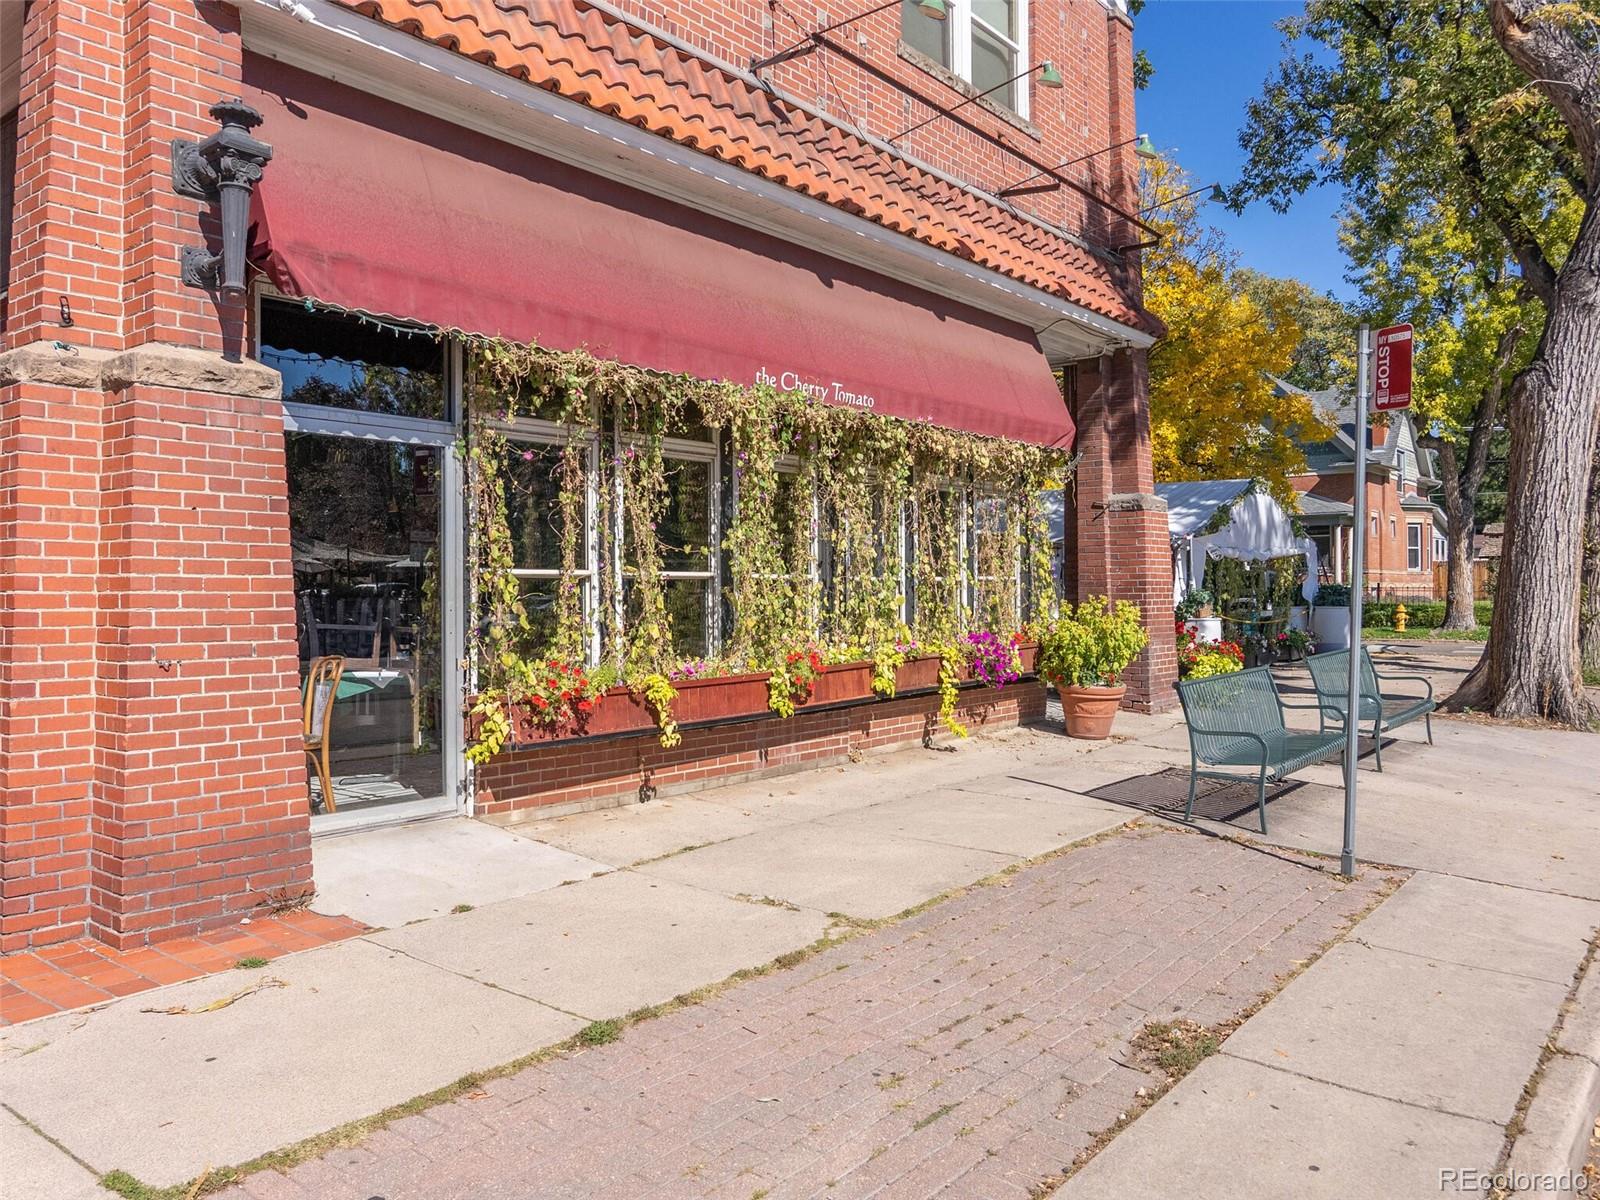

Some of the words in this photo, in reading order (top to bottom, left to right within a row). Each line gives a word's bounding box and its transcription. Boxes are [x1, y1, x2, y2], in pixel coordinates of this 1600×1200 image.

[755, 366, 778, 387] the
[780, 371, 829, 402] Cherry
[832, 382, 875, 408] Tomato
[1378, 346, 1390, 389] STOP
